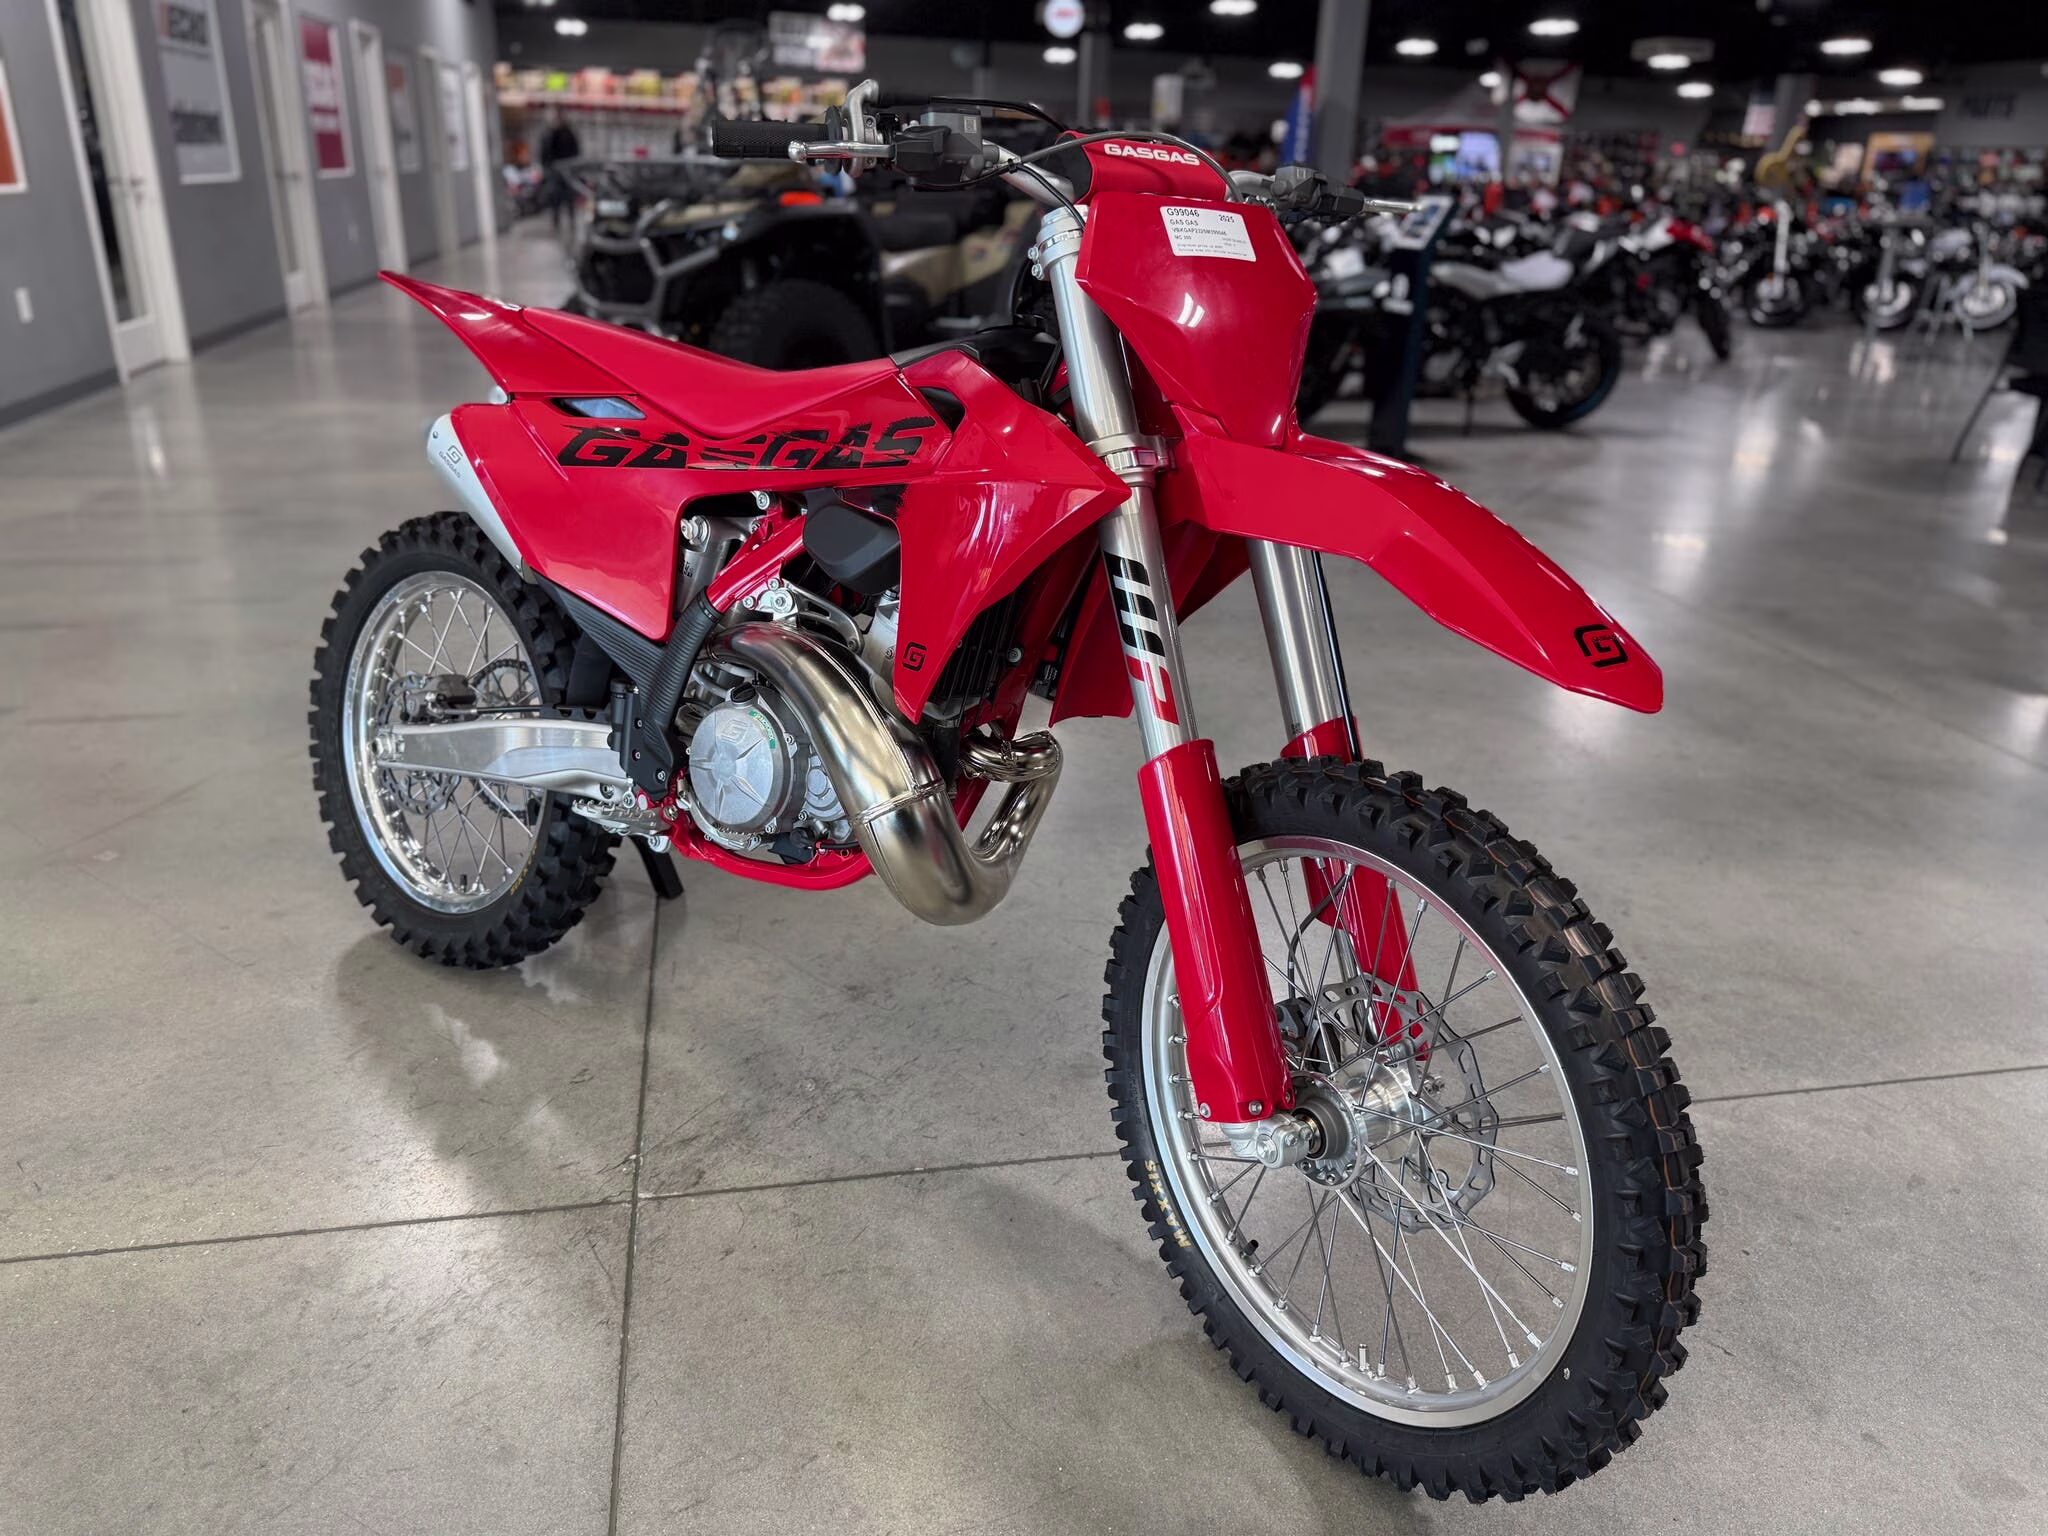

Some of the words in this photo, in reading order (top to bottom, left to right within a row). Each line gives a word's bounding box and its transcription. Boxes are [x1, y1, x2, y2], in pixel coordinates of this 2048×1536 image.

[1103, 143, 1200, 166] GASGAS
[1166, 207, 1200, 218] G99046
[556, 416, 938, 470] GASGAS
[1144, 1160, 1192, 1248] MAXXIS
